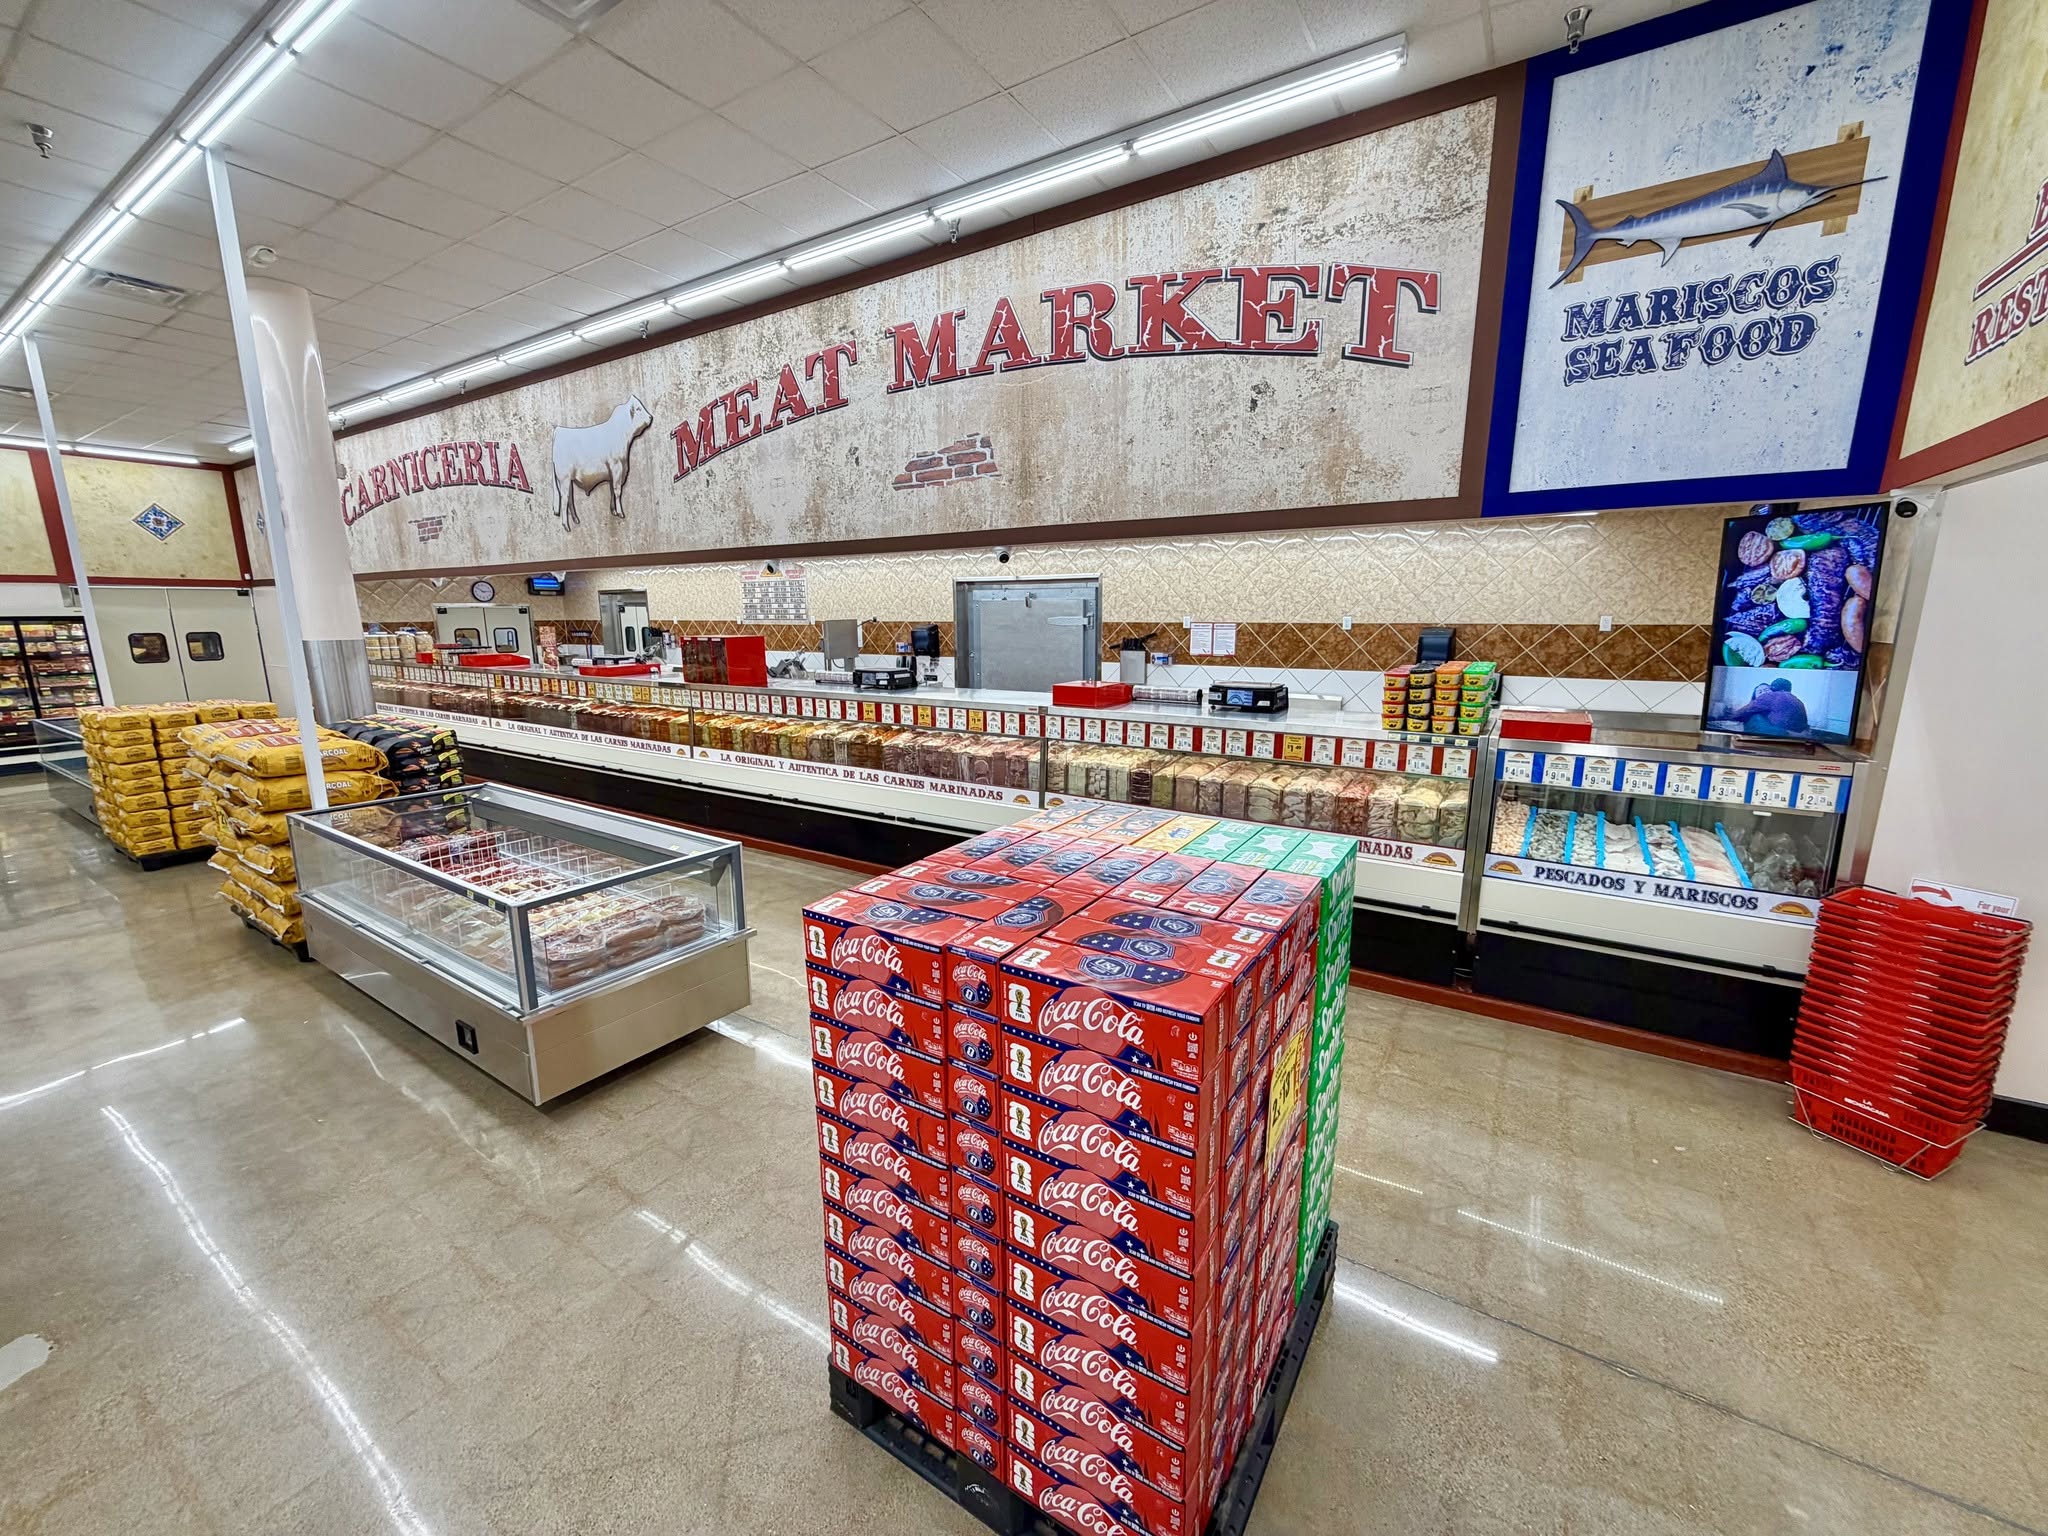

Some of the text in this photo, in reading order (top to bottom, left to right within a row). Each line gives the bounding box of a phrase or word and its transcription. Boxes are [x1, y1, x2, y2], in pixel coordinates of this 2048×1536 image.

[1561, 254, 1840, 341] MARISCOS
[1564, 311, 1820, 386] SEAFOOD
[670, 263, 1442, 484] MEAT MARKET
[340, 440, 534, 526] CARNICERIA
[508, 722, 515, 730] LA
[517, 724, 542, 735] ORIGINAL
[549, 728, 579, 740] AUTENTICA
[581, 733, 589, 742] DE
[591, 735, 603, 743] LAS
[604, 736, 628, 747] CARNES
[630, 740, 672, 754] MARINADAS
[720, 752, 1003, 801] LA ORIGINAL Y AUTENTICA DE LAS CARNES MARINADAS
[1358, 840, 1413, 860] INADAS
[1533, 865, 1759, 911] PESCADOS Y MARISCOS
[831, 934, 904, 974] Coca-Cola
[953, 964, 987, 982] Coca-Cola
[1094, 959, 1122, 974] USA
[833, 989, 905, 1028] Coca-Cola
[1015, 1012, 1026, 1020] FIFA
[1038, 997, 1144, 1046] Coca-Cola
[953, 1022, 988, 1041] Coca-Cola
[836, 1039, 905, 1081] Coca-Cola
[1016, 1071, 1027, 1079] FIFA
[954, 1077, 987, 1097] Coca-Cola
[1038, 1060, 1142, 1111] Coca-Cola
[840, 1089, 910, 1132] Coca-Cola
[844, 1138, 912, 1182] Coca-Cola
[957, 1131, 990, 1151] Coca-Cola
[1038, 1119, 1141, 1173] Coca-Cola
[845, 1184, 913, 1230] Coca-Cola
[957, 1185, 990, 1205] Coca-Cola
[1039, 1177, 1139, 1233] Coca-Cola
[848, 1231, 915, 1278] Coca-Cola
[958, 1236, 990, 1259] Coca-Cola
[1042, 1231, 1140, 1290] Coca-Cola
[849, 1276, 916, 1325] Coca-Cola
[958, 1287, 990, 1310] Coca-Cola
[1041, 1285, 1137, 1346] Coca-Cola
[853, 1318, 918, 1369] Coca-Cola
[961, 1335, 993, 1358] Coca-Cola
[855, 1361, 920, 1413] Coca-Cola
[1041, 1340, 1137, 1400] Coca-Cola
[961, 1382, 993, 1405] Coca-Cola
[961, 1427, 992, 1451] Coca-Cola
[1041, 1388, 1134, 1453] Coca-Cola
[1041, 1438, 1134, 1504] Coca-Cola
